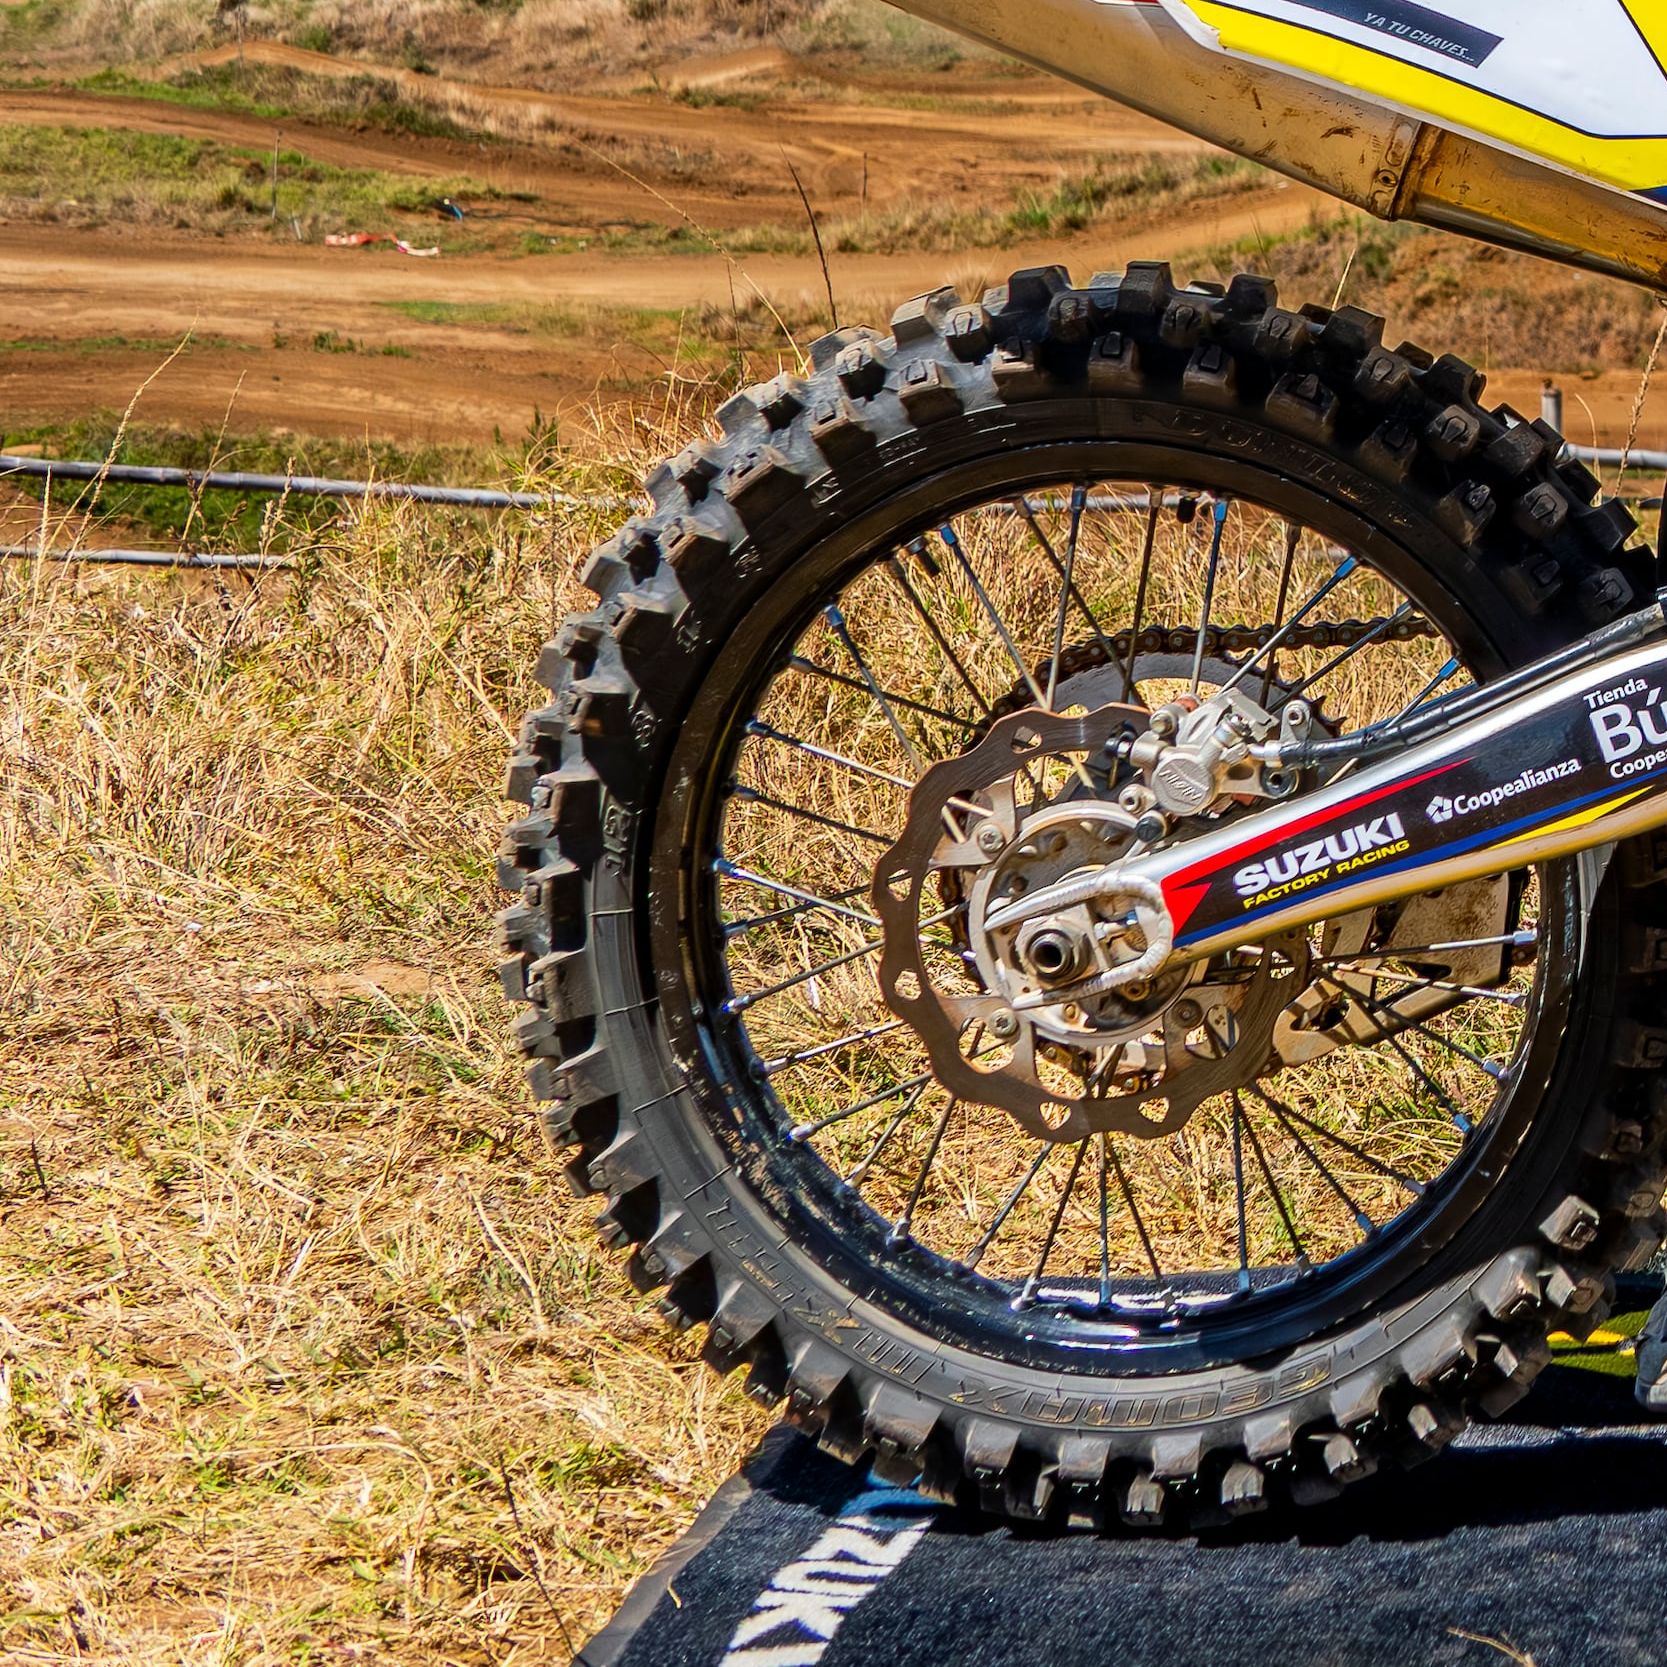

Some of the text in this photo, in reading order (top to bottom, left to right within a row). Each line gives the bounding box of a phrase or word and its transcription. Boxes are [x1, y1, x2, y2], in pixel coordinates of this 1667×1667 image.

[1363, 11, 1386, 28] YA
[1390, 20, 1409, 37] TU
[1583, 678, 1649, 710] Tienda
[1452, 757, 1583, 817] Coopealianza
[1232, 811, 1407, 896] SUZUKI
[1243, 839, 1411, 910] FACTORY RACING
[717, 1473, 940, 1667] UZUKI
